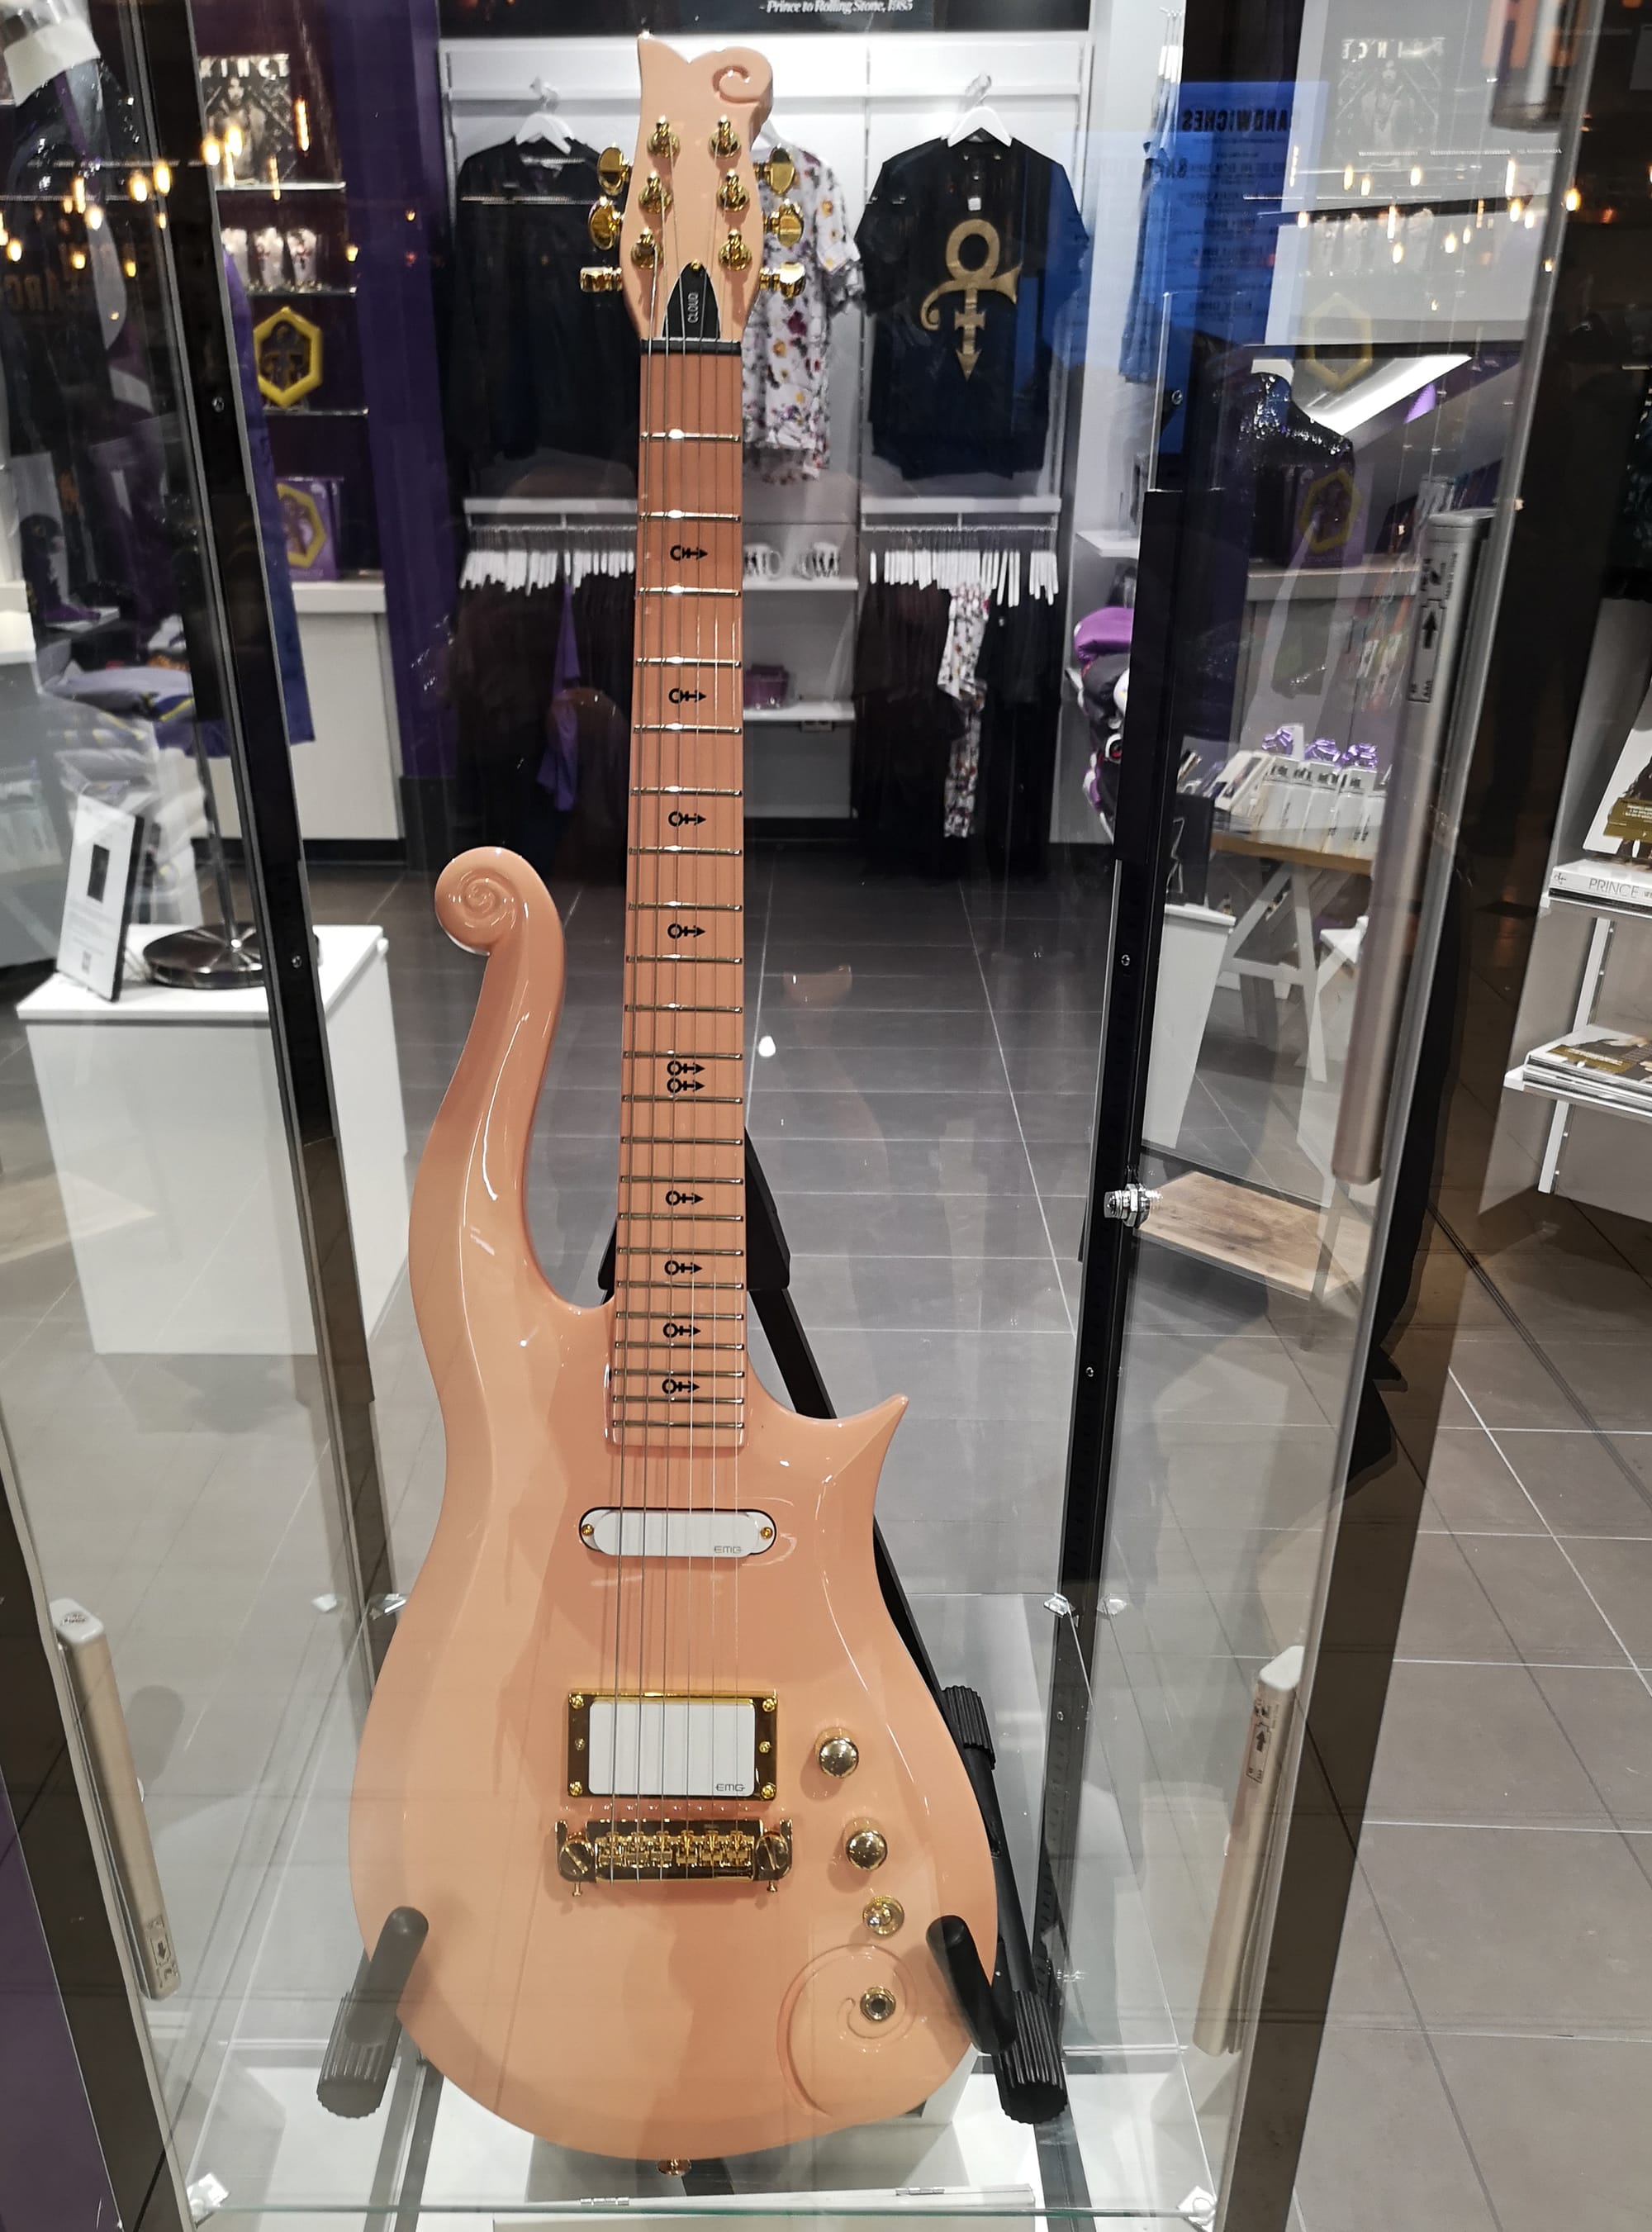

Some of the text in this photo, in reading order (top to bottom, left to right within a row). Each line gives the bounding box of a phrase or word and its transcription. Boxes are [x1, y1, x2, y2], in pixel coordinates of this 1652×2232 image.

[767, 0, 801, 13] Prince
[802, 0, 814, 12] to
[814, 0, 852, 15] Rolling
[853, 0, 885, 13] Stone,
[687, 292, 699, 323] CLOUD
[1588, 878, 1640, 898] PRINCE
[714, 1546, 742, 1554] EMG
[714, 1783, 746, 1792] EMG
